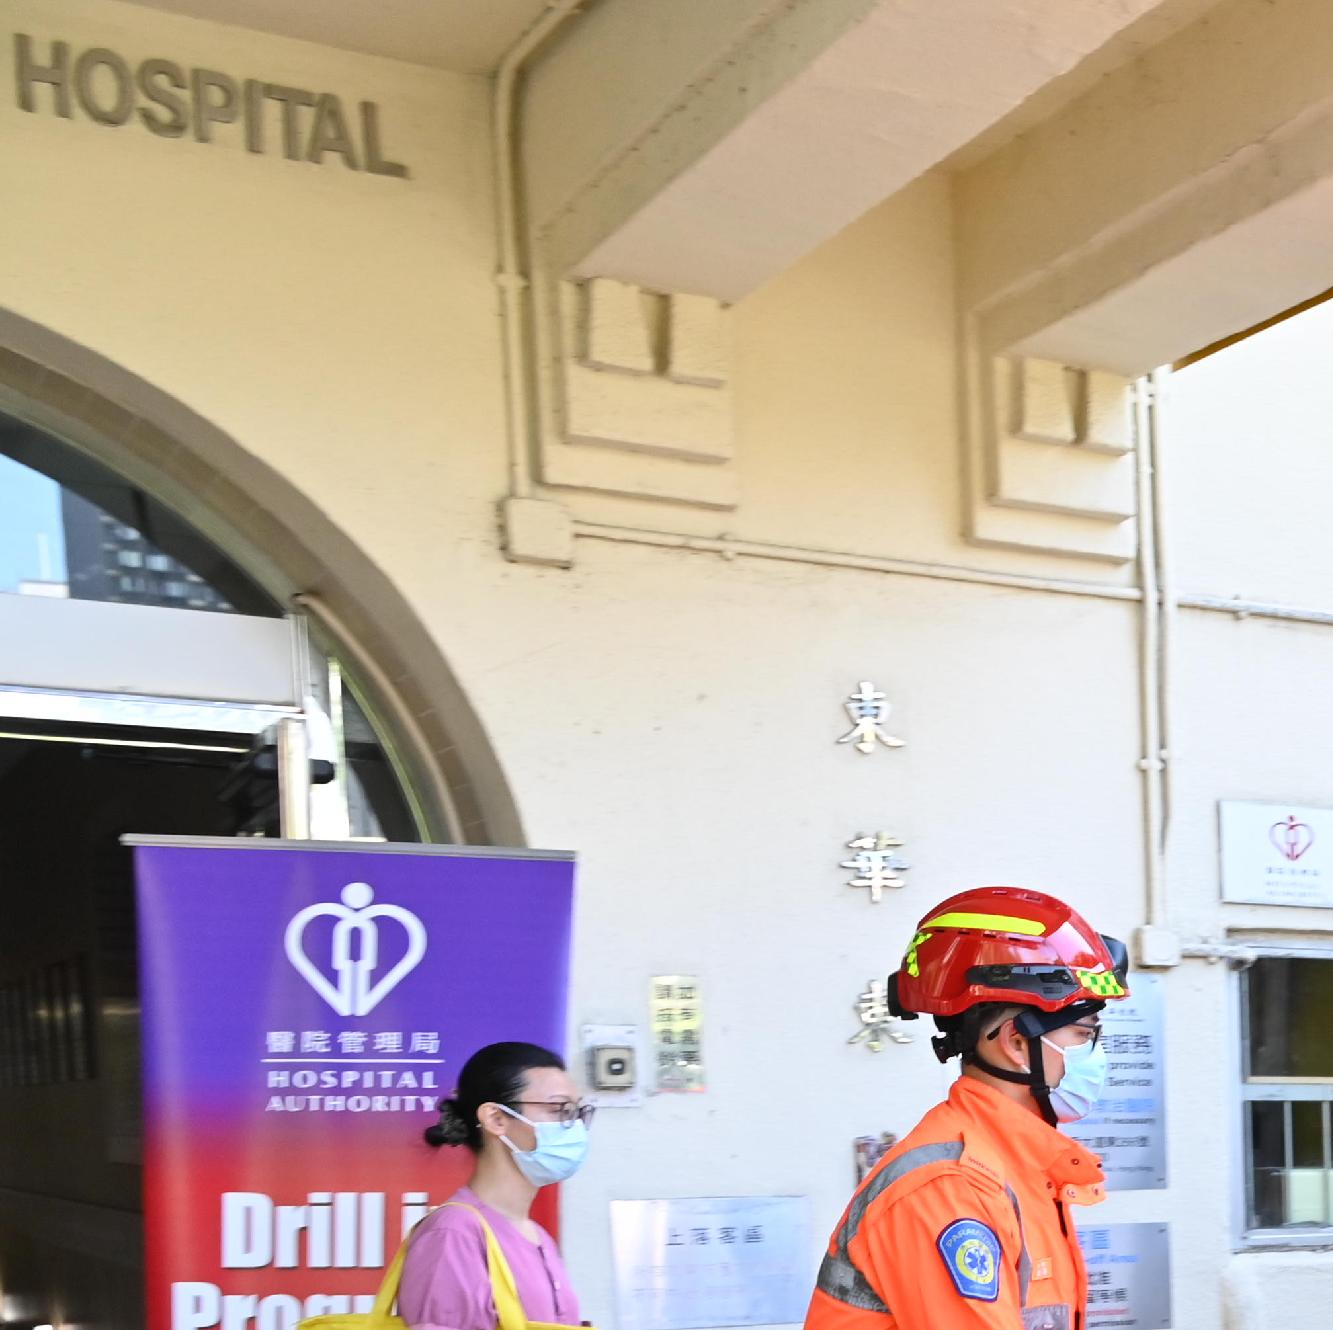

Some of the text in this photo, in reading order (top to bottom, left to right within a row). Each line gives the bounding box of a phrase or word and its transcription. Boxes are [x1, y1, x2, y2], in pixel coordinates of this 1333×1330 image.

[13, 32, 411, 179] HOSPITAL
[266, 1031, 441, 1053] 醫院管理局
[267, 1070, 439, 1089] HOSPITAL
[265, 1095, 440, 1112] AUTHORITY
[220, 1191, 386, 1269] Drill
[665, 1224, 763, 1247] 上落客區
